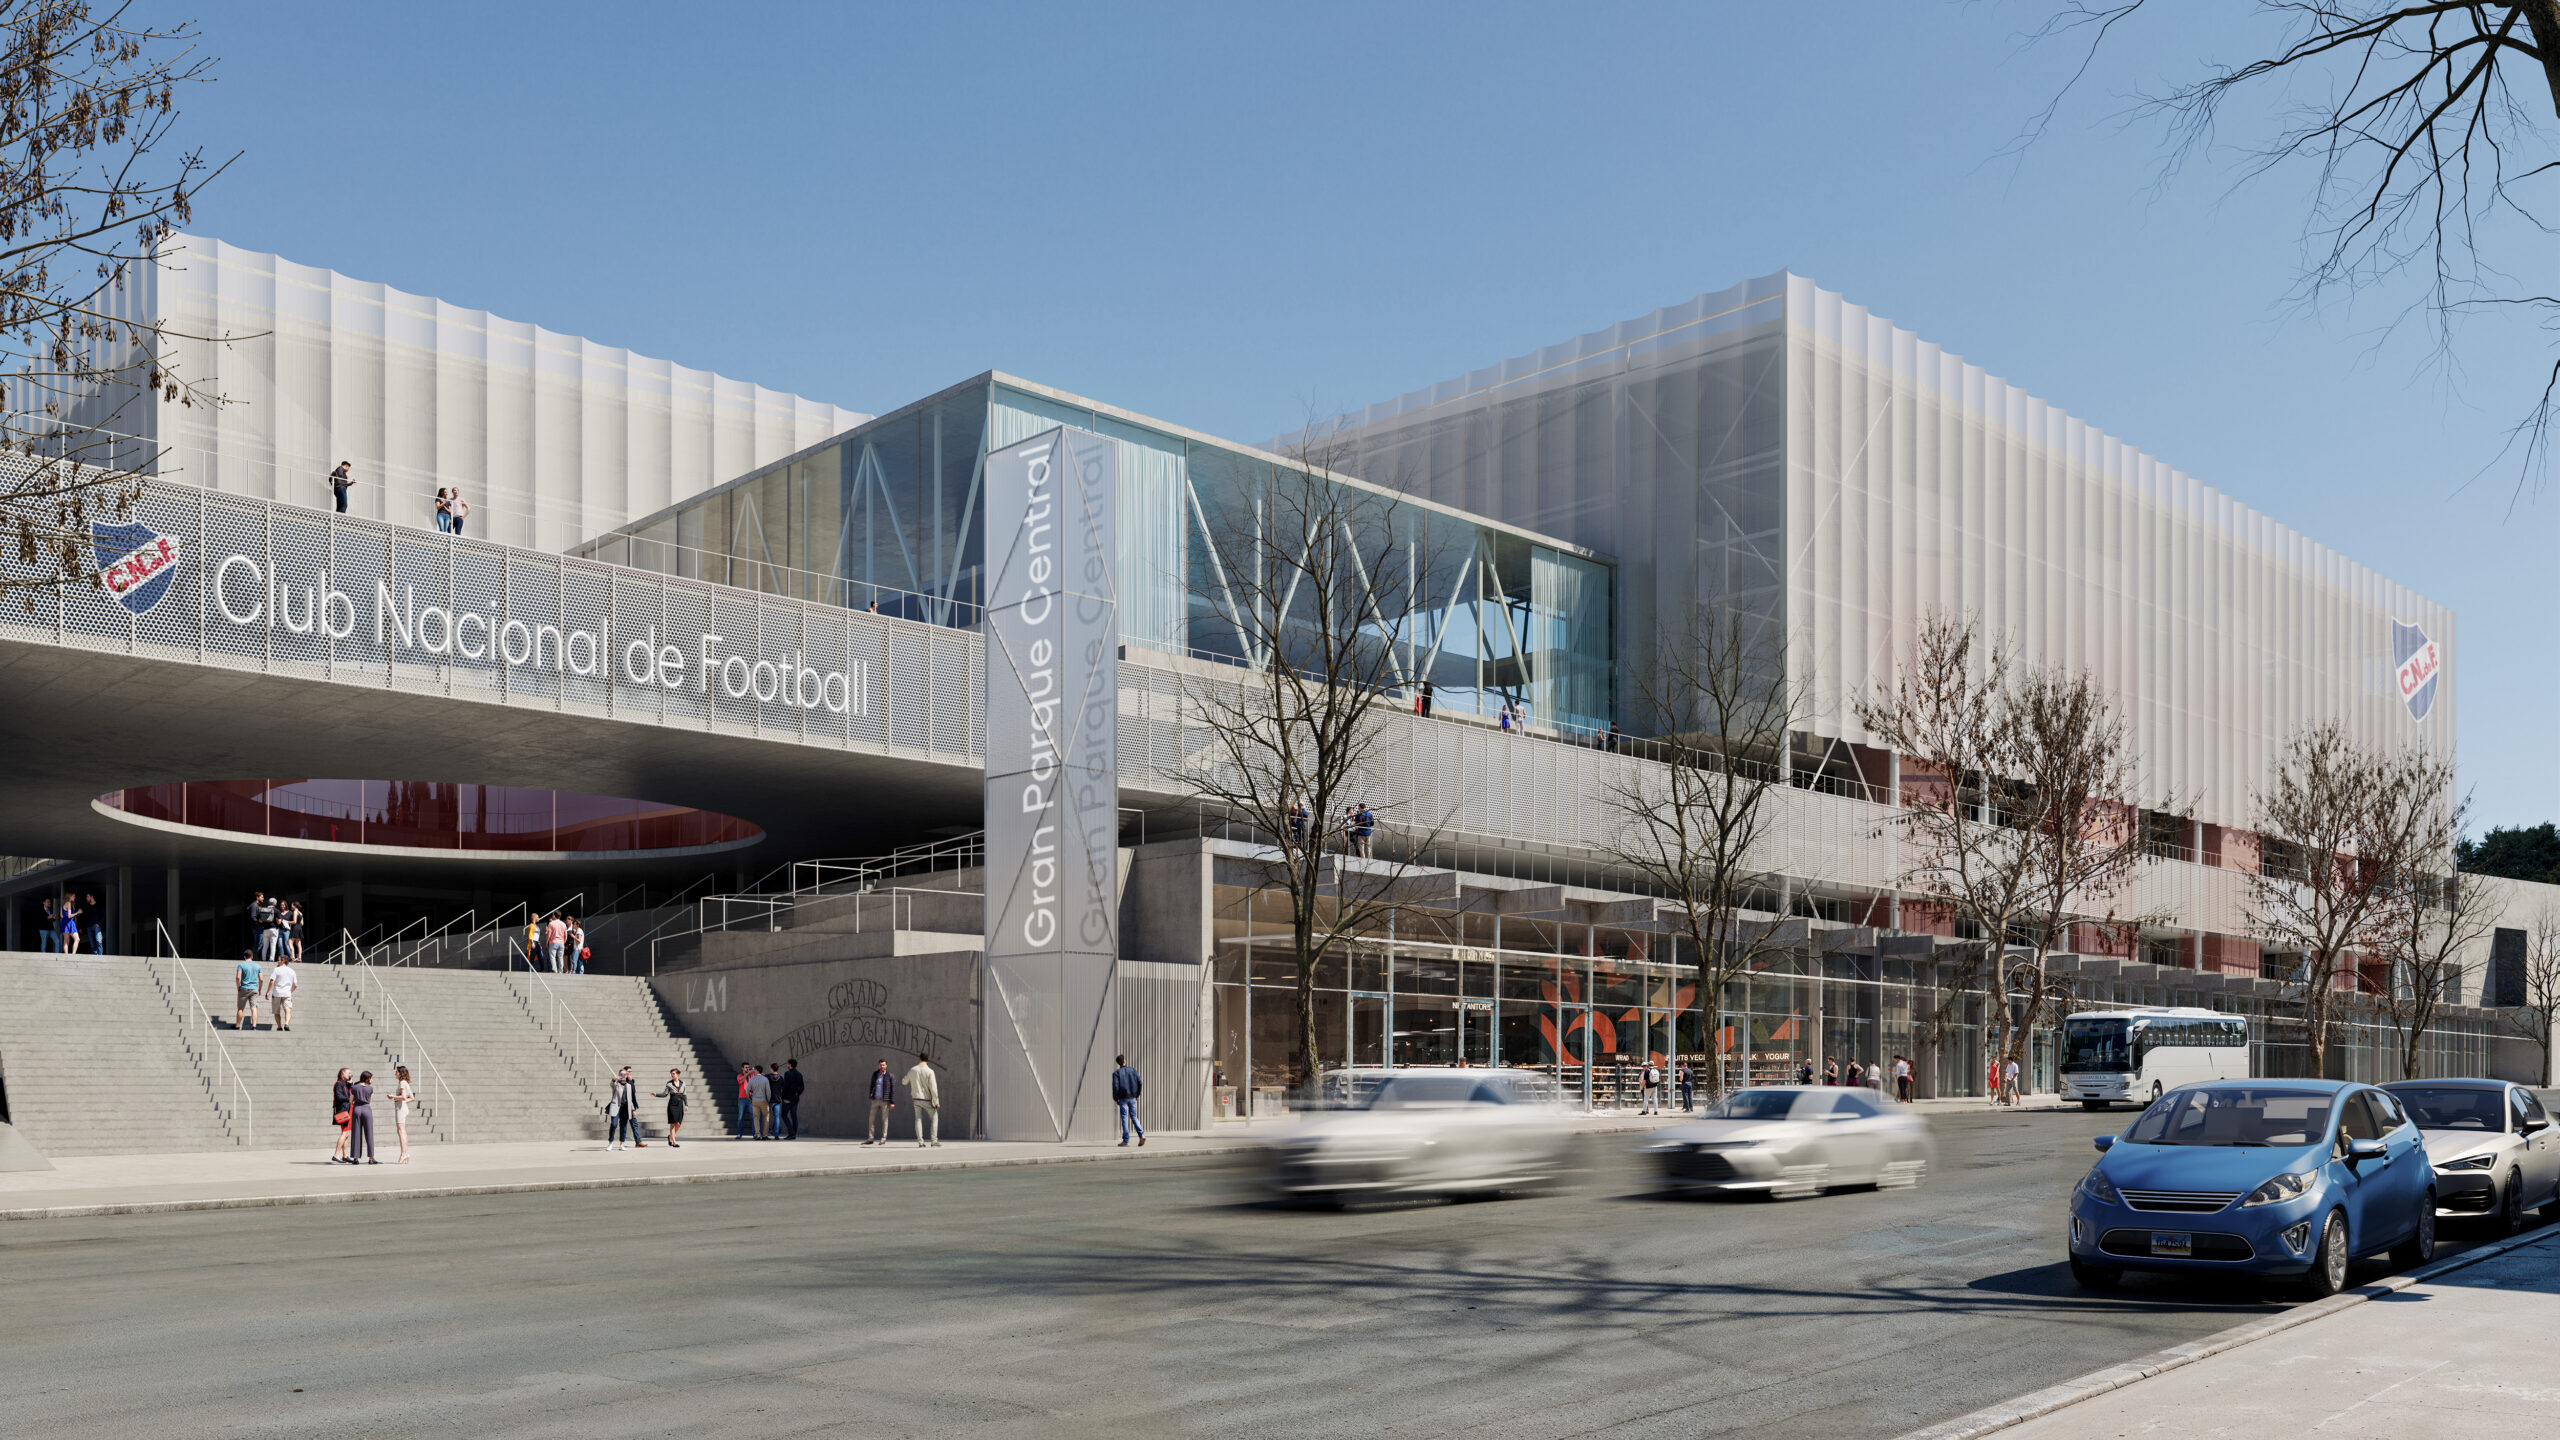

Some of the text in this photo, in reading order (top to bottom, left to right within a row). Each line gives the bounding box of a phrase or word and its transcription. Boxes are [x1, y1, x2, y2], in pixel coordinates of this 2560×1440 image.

[216, 554, 867, 716] Club Nacional de Football
[1019, 443, 1061, 948] Gran Parque Central
[1075, 443, 1112, 948] Gran Parque Central
[787, 1019, 842, 1058] PARQUE
[1764, 1052, 1790, 1061] YOGUR
